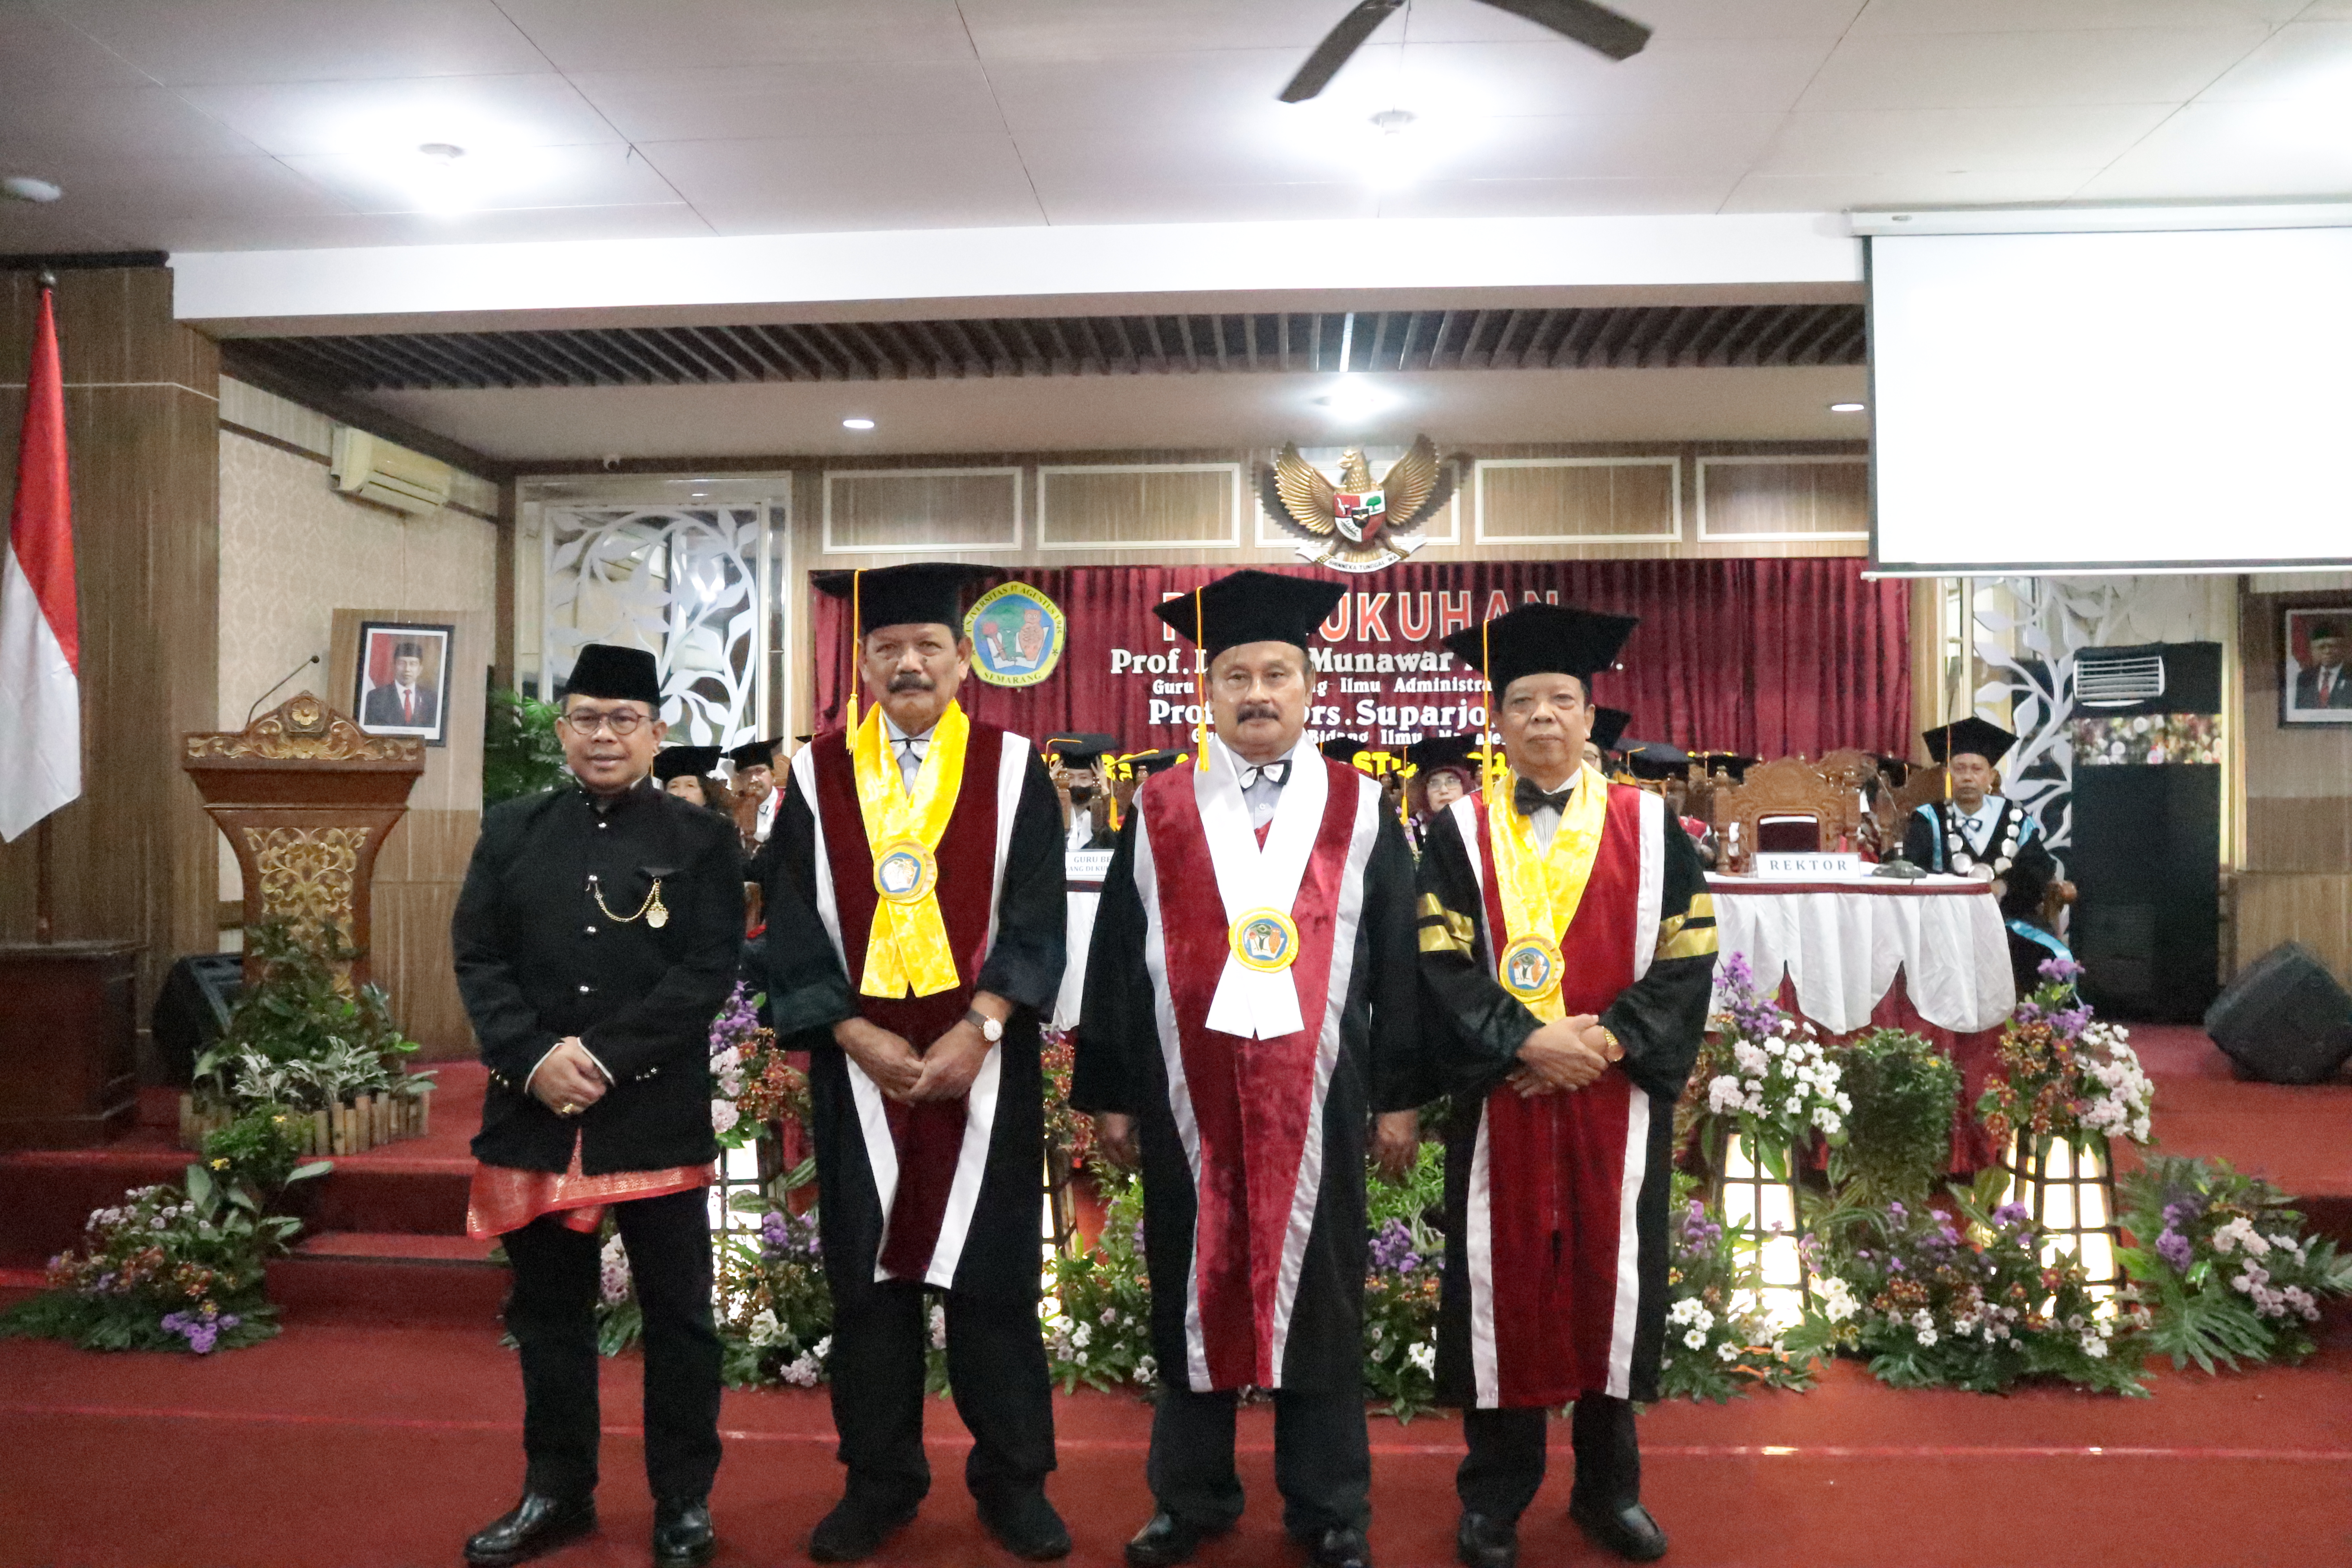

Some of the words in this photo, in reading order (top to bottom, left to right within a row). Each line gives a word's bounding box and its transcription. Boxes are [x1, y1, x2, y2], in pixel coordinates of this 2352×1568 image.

[1328, 561, 1357, 570] BHINNEKA
[1359, 561, 1385, 570] TUNGGAL
[965, 588, 1008, 632] UNIVERSITAS
[1020, 588, 1055, 615] AGUSTUS
[1054, 615, 1062, 634] 1945
[1111, 648, 1189, 675] Prof.
[1308, 647, 1454, 673] Munawar
[984, 672, 1041, 684] SEMARANG
[1152, 679, 1194, 695] Guru
[1340, 677, 1381, 693] Ilmu
[1380, 729, 1423, 744] Ilmu
[1769, 860, 1847, 871] REKTOR
